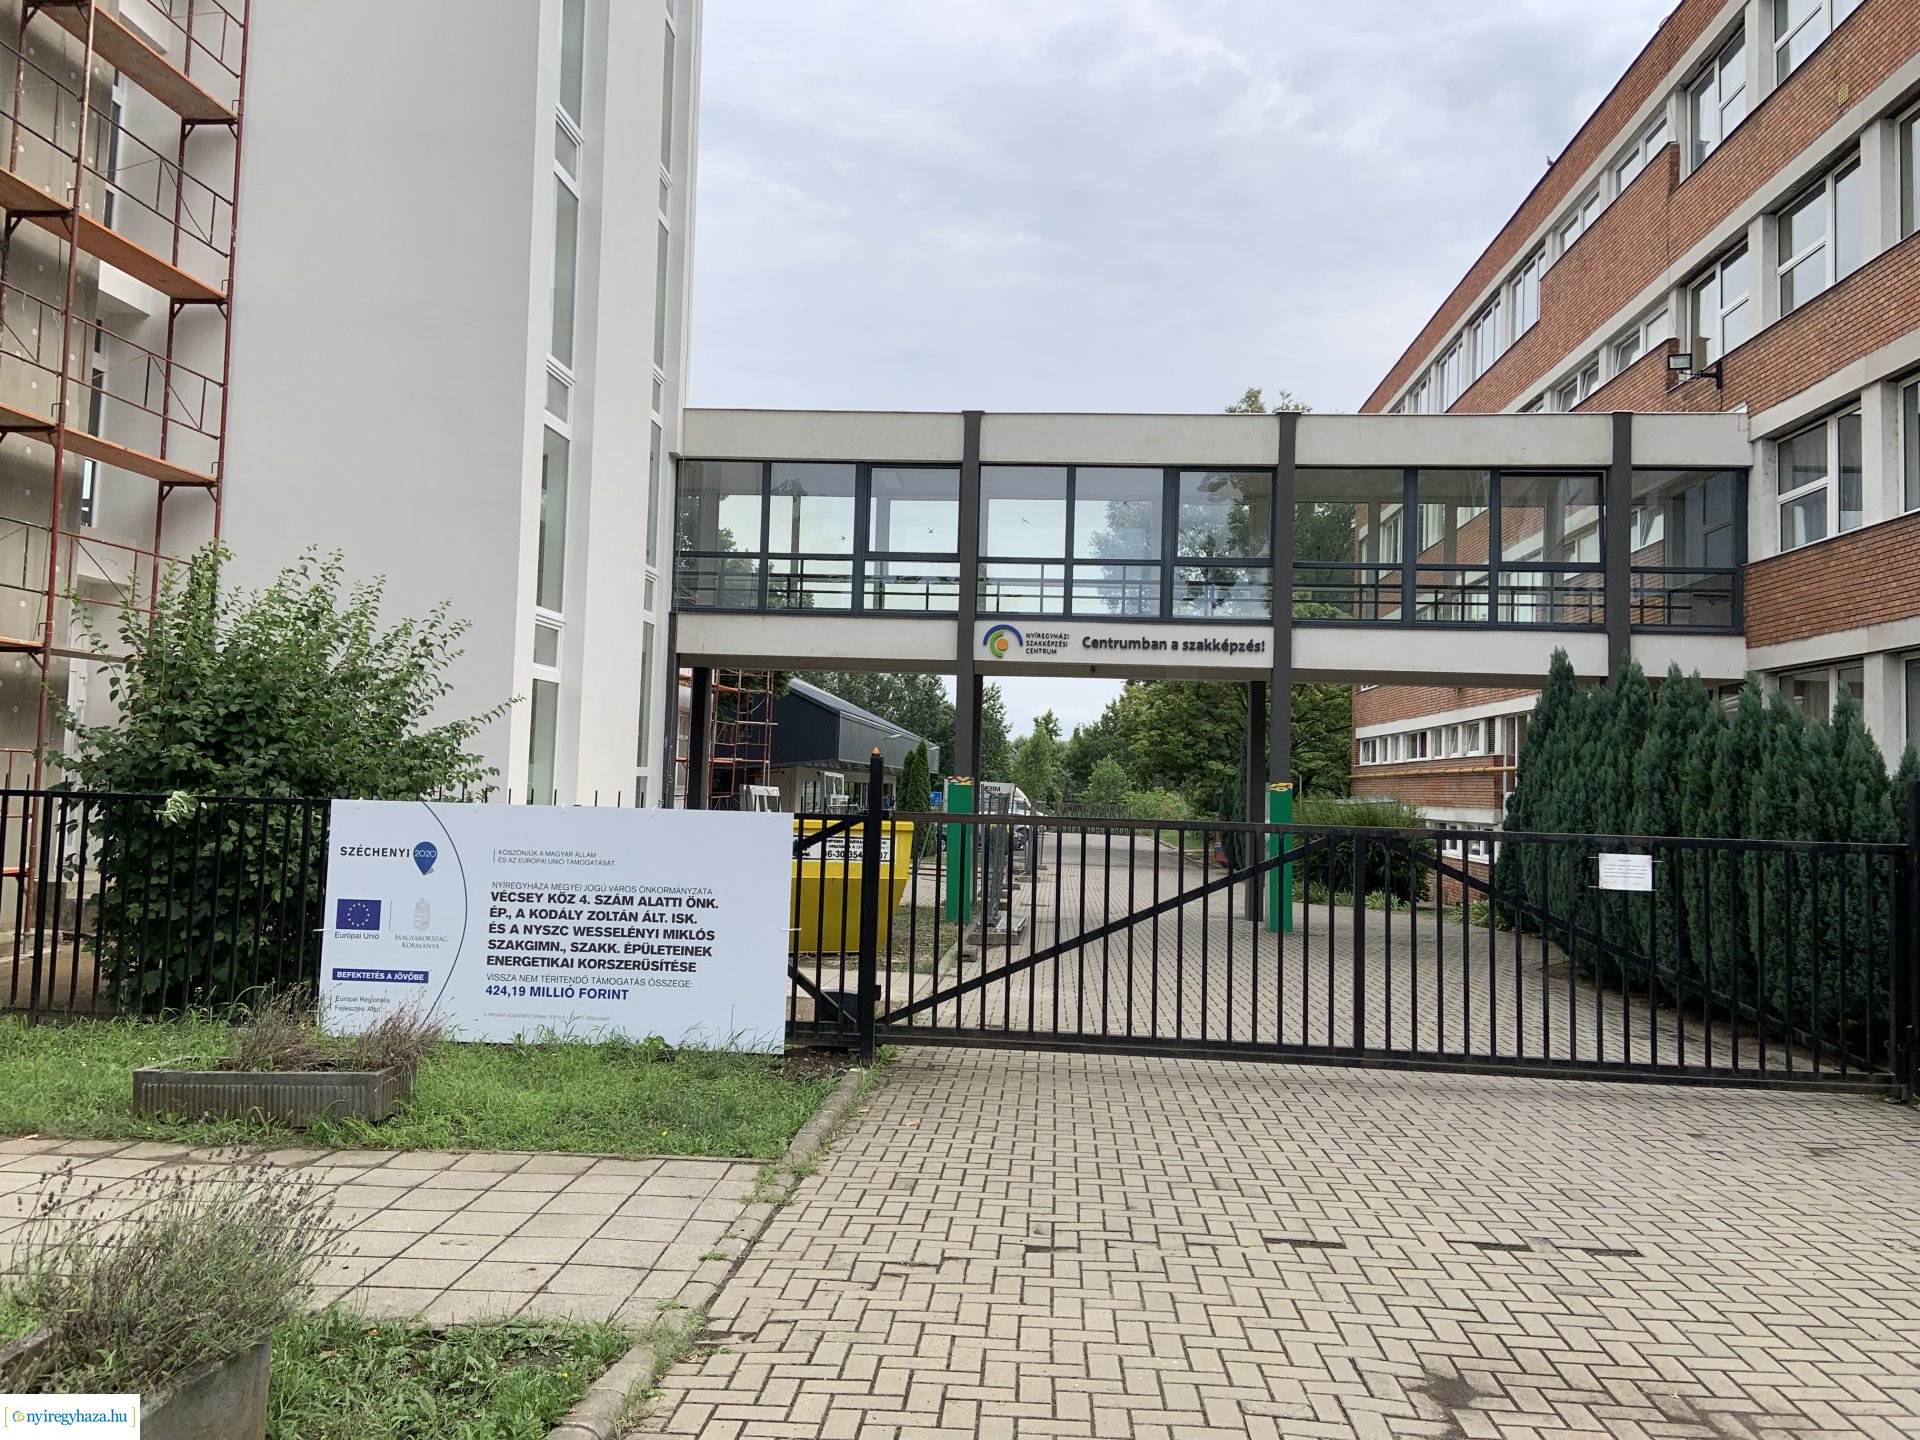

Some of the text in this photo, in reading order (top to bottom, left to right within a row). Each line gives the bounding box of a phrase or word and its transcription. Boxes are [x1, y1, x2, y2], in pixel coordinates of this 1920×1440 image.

[1082, 636, 1266, 656] Centrumban a szakképzés!
[340, 844, 437, 858] SZÉCHENYI 2020
[492, 881, 713, 895] NYÍREGYHÁZA MEGYEI JOGÚ VÁROS ÖNKORMÁNYZATA
[490, 890, 719, 908] VÉCSEY KÖZ 4. SZÁM ALATTI ÖNK.
[490, 906, 698, 924] ÉP., A KODÁLY ZOLTÁN ÁLT. ISK.
[334, 932, 362, 940] Európai
[488, 922, 716, 941] ÉS A NYSZC WESSELÉNYI MIKLÓS
[487, 940, 713, 957] SZAKGIMN., SZAKK. ÉPÜLETEINEK
[486, 956, 697, 972] ENERGETIKAI KORSZERŰSÍTÉSE
[337, 971, 385, 980] BEFEKTETÉS
[486, 973, 693, 988] VISSZA NEM TÉRÍTENDŐ TÁMOGATÁS ÖSSZEGE:
[486, 985, 629, 1000] 424,19 MILLIÓ FORINT
